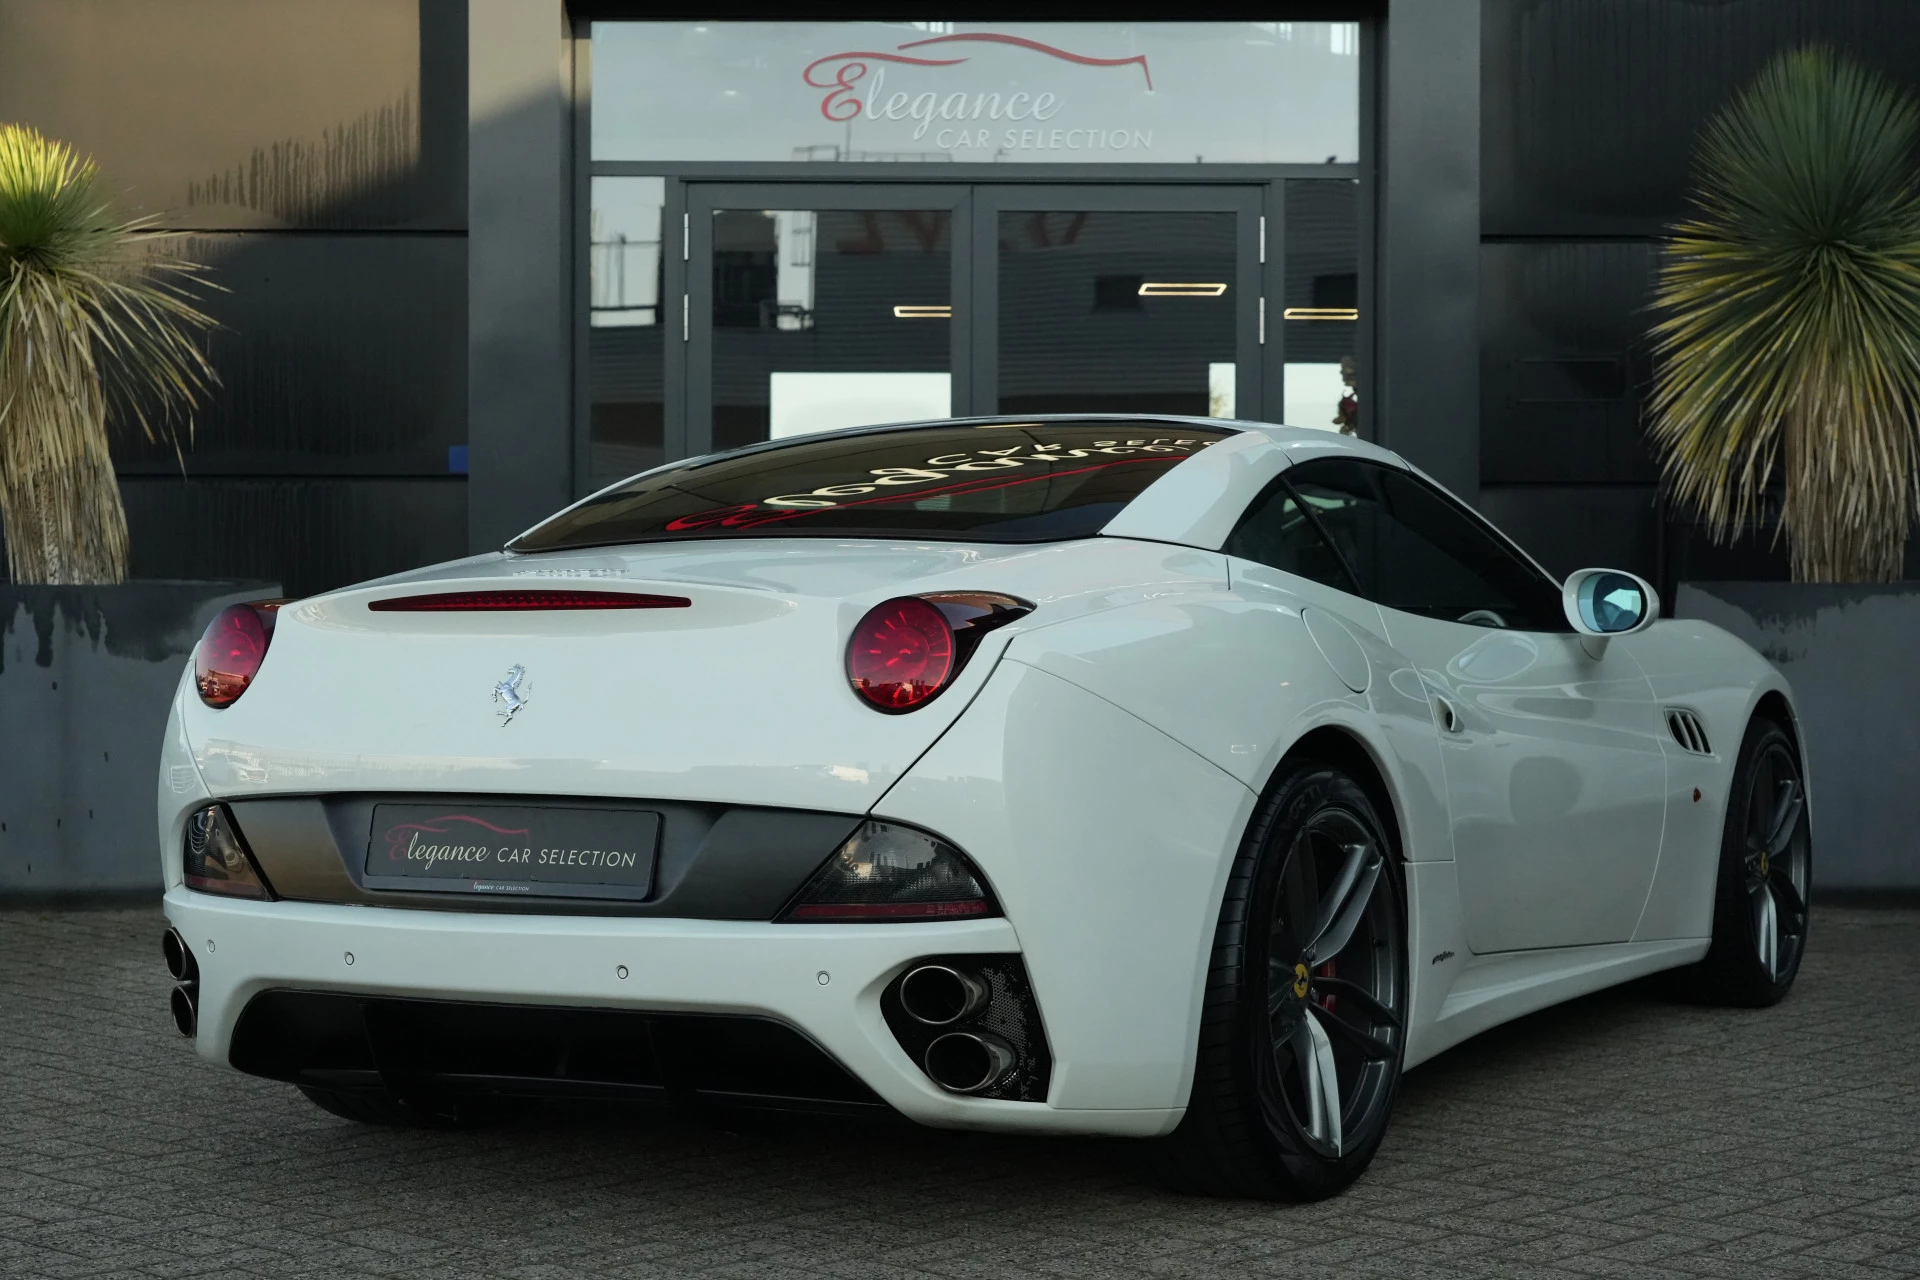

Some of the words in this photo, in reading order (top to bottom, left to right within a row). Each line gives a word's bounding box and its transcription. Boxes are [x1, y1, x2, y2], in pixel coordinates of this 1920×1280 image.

[803, 51, 1065, 141] Elegance
[935, 128, 990, 150] CAR
[1003, 128, 1154, 150] SELECTION
[385, 824, 490, 870] Elegance
[497, 847, 531, 864] CAR
[538, 849, 636, 868] SELECTION
